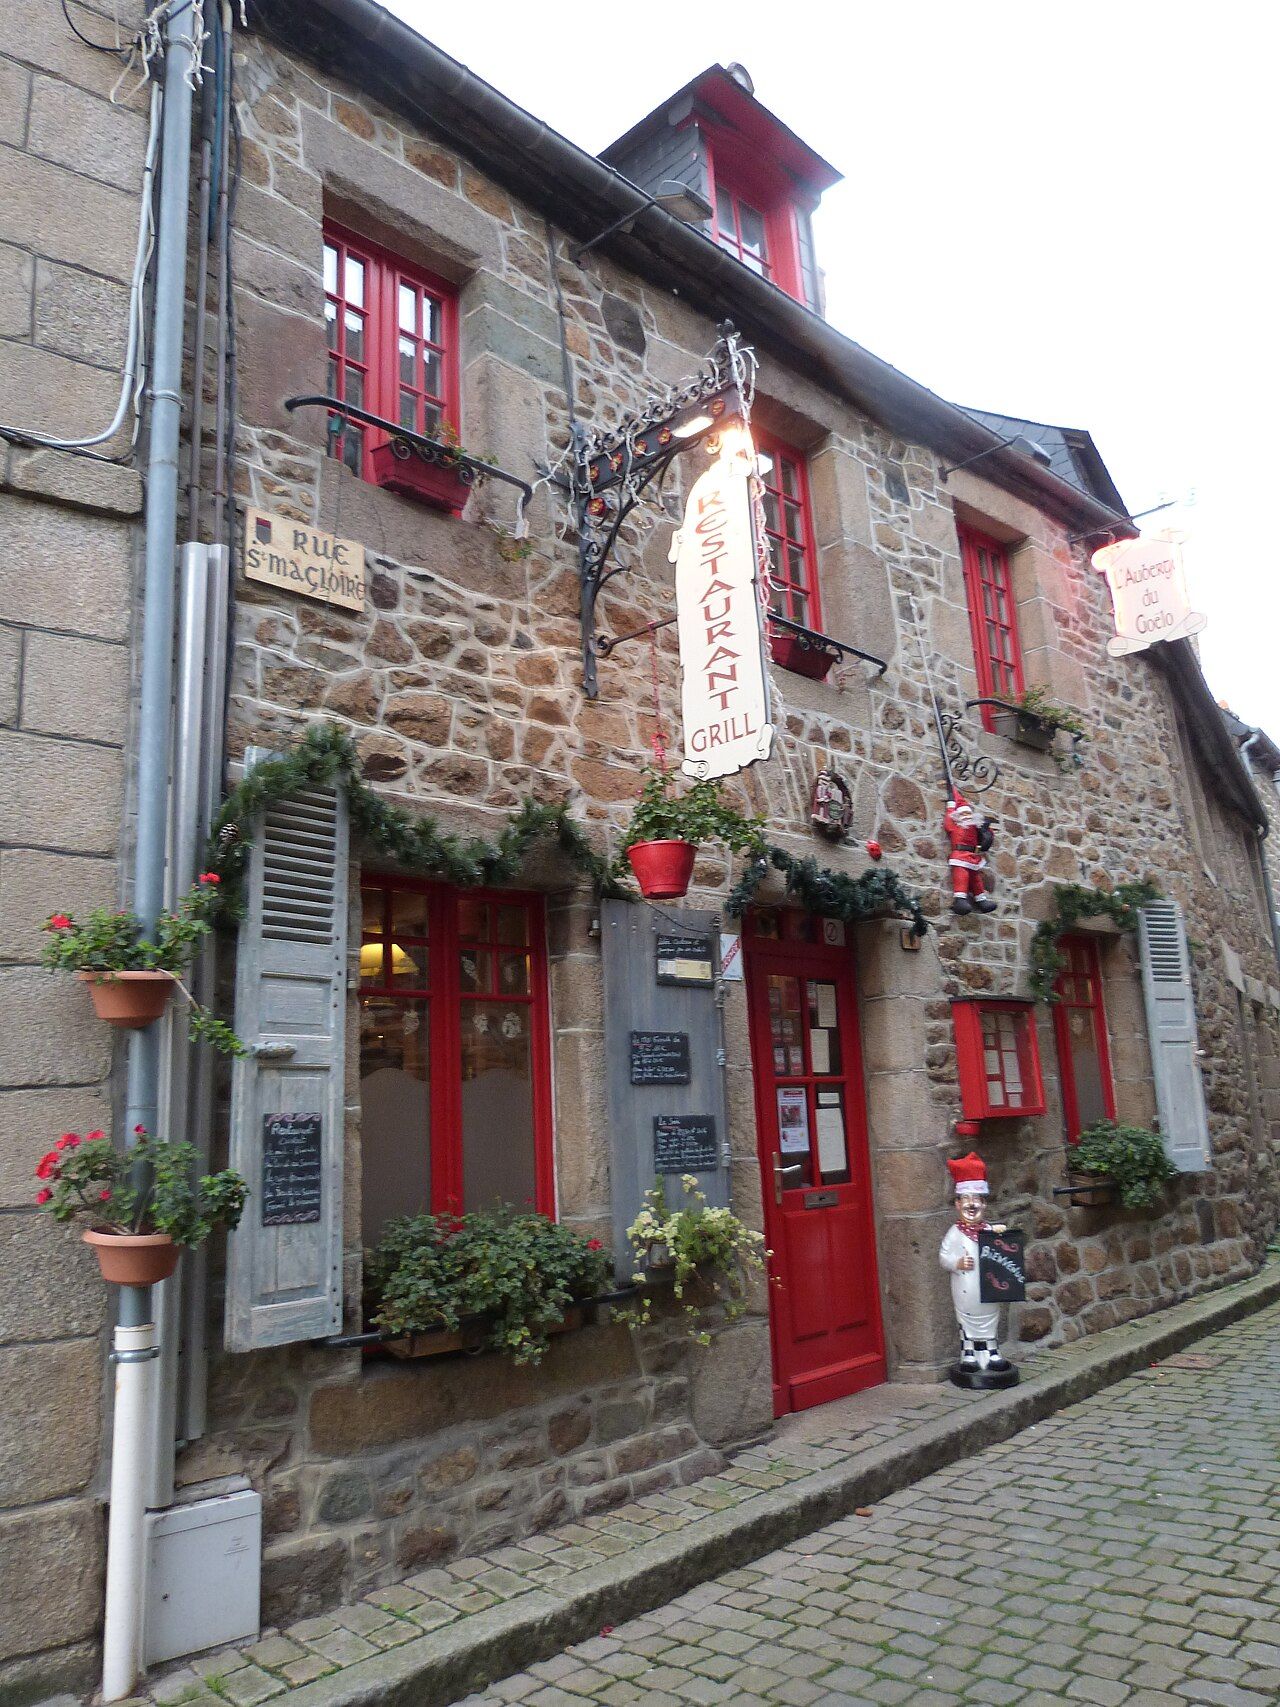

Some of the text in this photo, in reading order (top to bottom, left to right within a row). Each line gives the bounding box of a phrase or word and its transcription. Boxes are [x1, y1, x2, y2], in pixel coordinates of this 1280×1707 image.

[293, 529, 350, 566] RUE
[695, 490, 742, 711] RESTAURANT
[1143, 589, 1159, 607] du
[691, 712, 757, 752] GRILL
